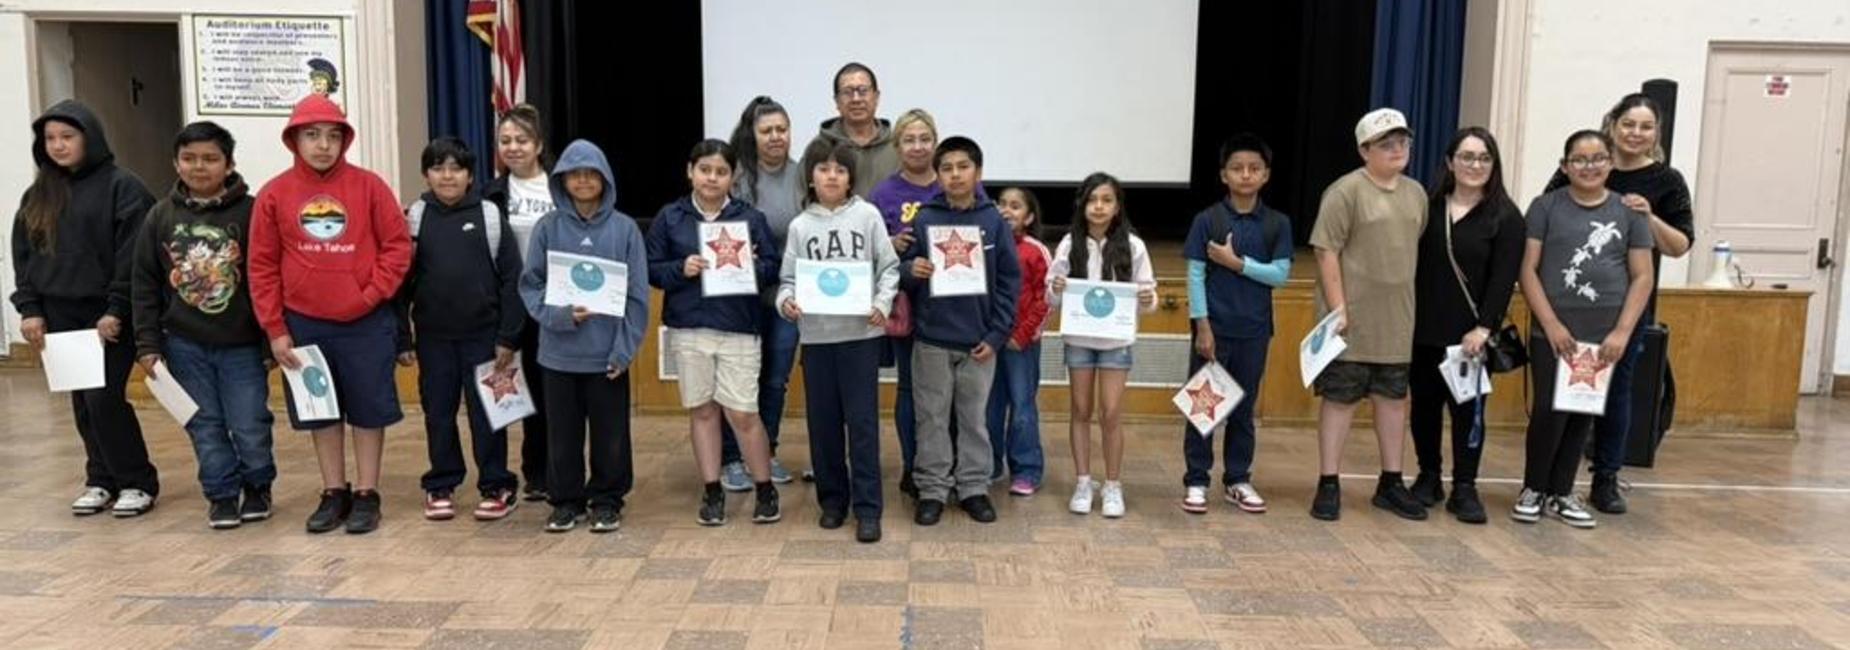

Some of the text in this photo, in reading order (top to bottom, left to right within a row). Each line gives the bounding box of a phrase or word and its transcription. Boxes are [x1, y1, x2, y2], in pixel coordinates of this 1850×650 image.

[206, 20, 330, 31] Auditorium Etiquette
[297, 240, 356, 254] Lake Tahoe
[806, 230, 864, 261] GAP
